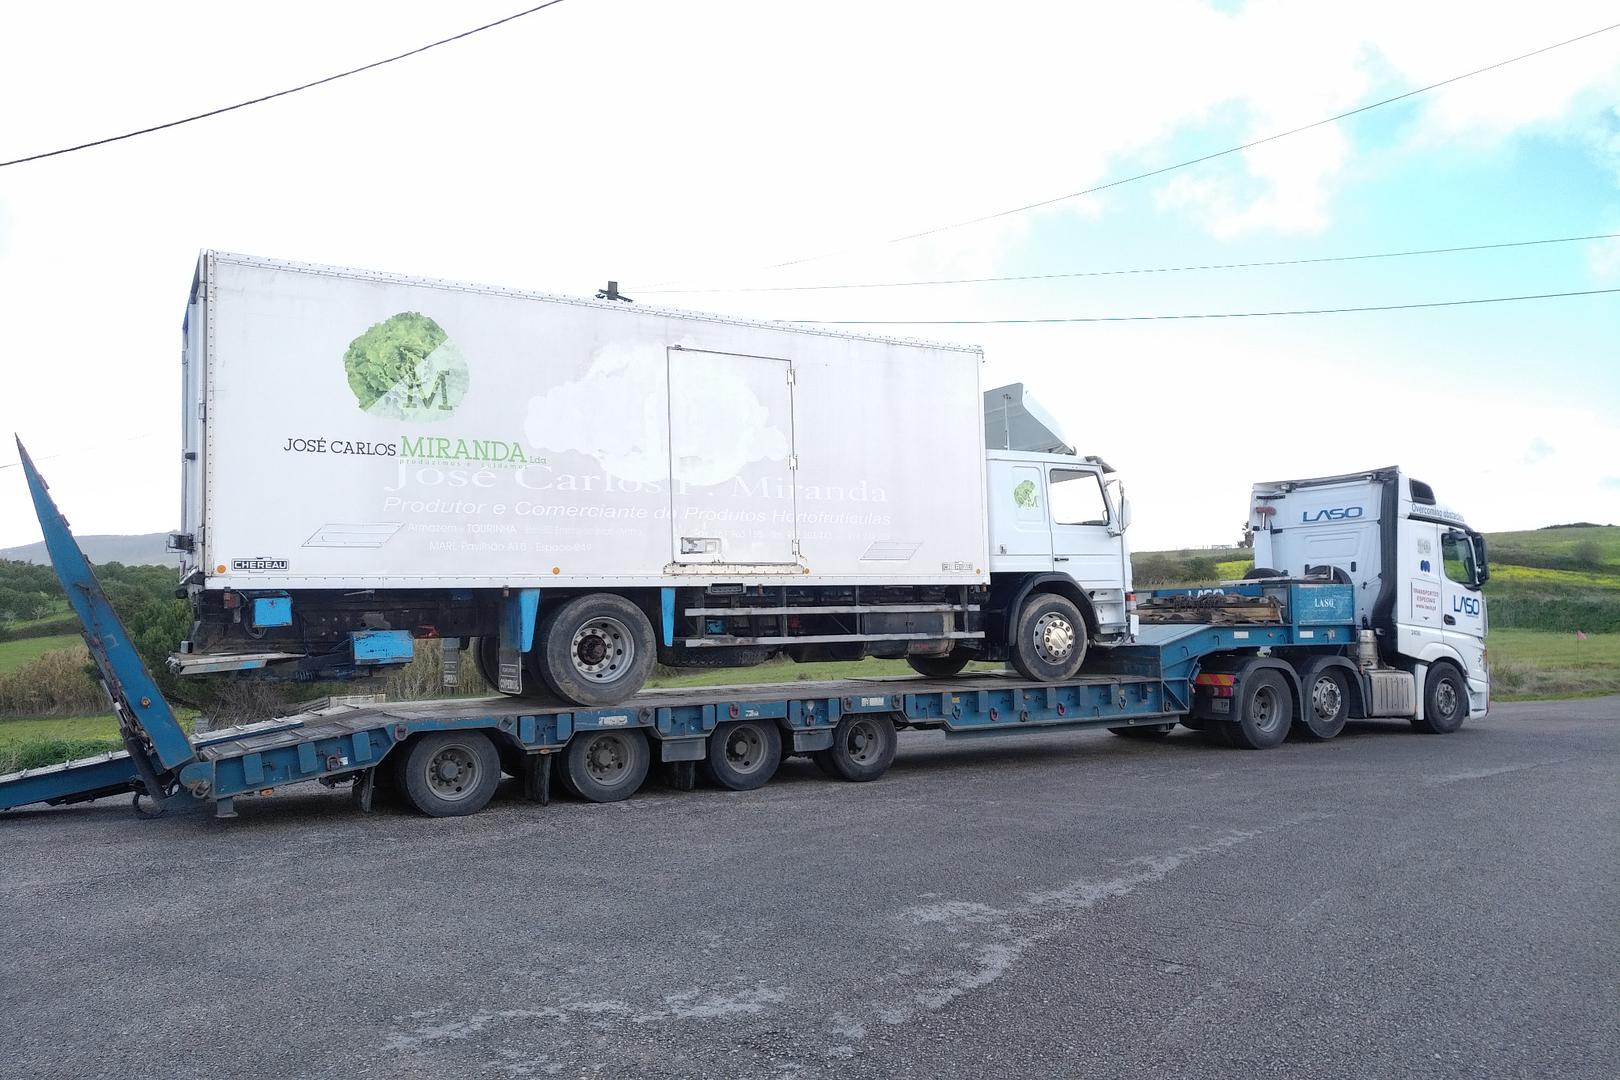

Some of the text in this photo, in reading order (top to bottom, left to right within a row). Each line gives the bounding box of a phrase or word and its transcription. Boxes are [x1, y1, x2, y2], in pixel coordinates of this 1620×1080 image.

[283, 436, 327, 454] JOSÉ
[330, 440, 397, 457] CARLOS
[399, 435, 528, 463] MIRANDA
[383, 458, 497, 492] José
[730, 475, 889, 502] Miranda
[384, 496, 487, 514] Produtor
[492, 503, 507, 515] e
[515, 501, 649, 520] Comerciante
[684, 506, 768, 522] Produtos
[1303, 507, 1363, 522] LASO
[1411, 503, 1442, 517] Overcoming
[233, 561, 287, 570] CHEREAU
[1314, 598, 1336, 609] LASO
[1453, 594, 1480, 615] LASO
